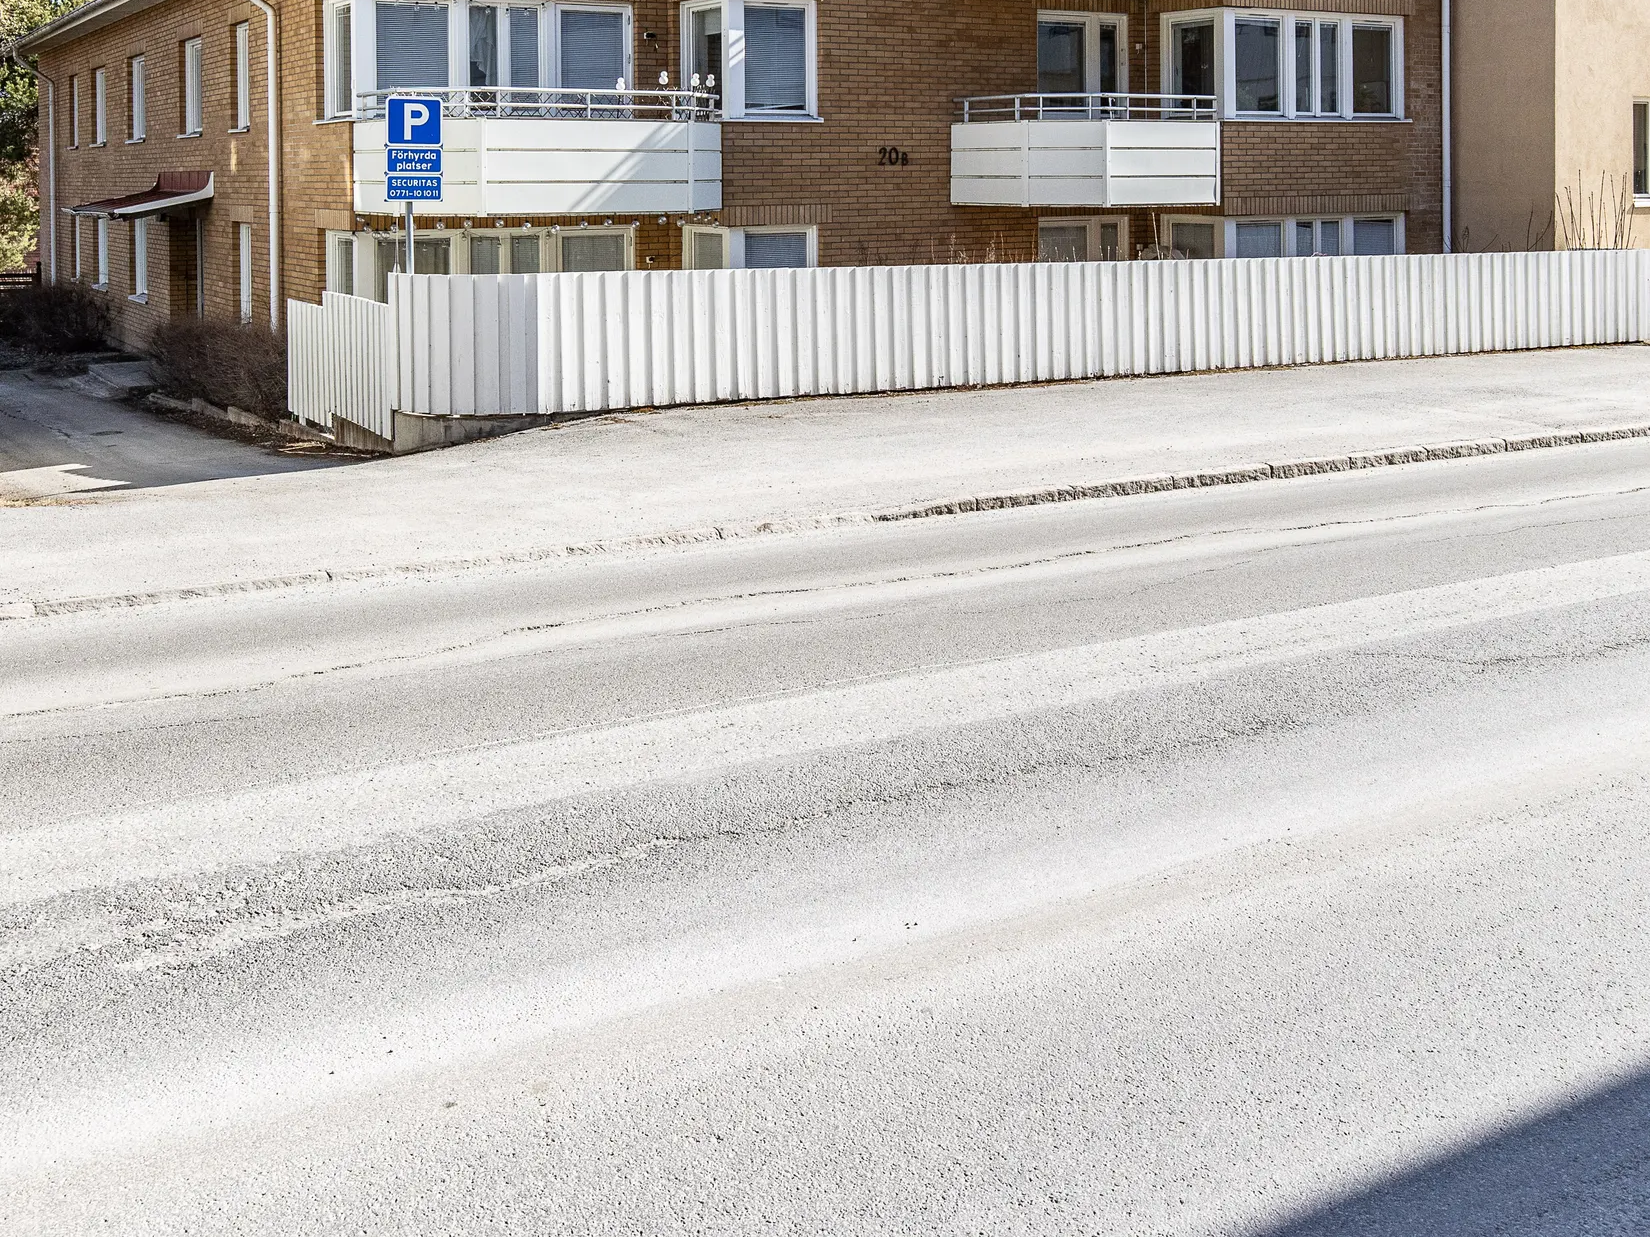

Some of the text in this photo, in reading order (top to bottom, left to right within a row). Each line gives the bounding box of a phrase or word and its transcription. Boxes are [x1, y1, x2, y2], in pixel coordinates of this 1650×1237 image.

[403, 102, 430, 141] P
[391, 150, 437, 161] Förhyrda
[396, 162, 433, 172] platser
[391, 179, 438, 187] SECURITAS
